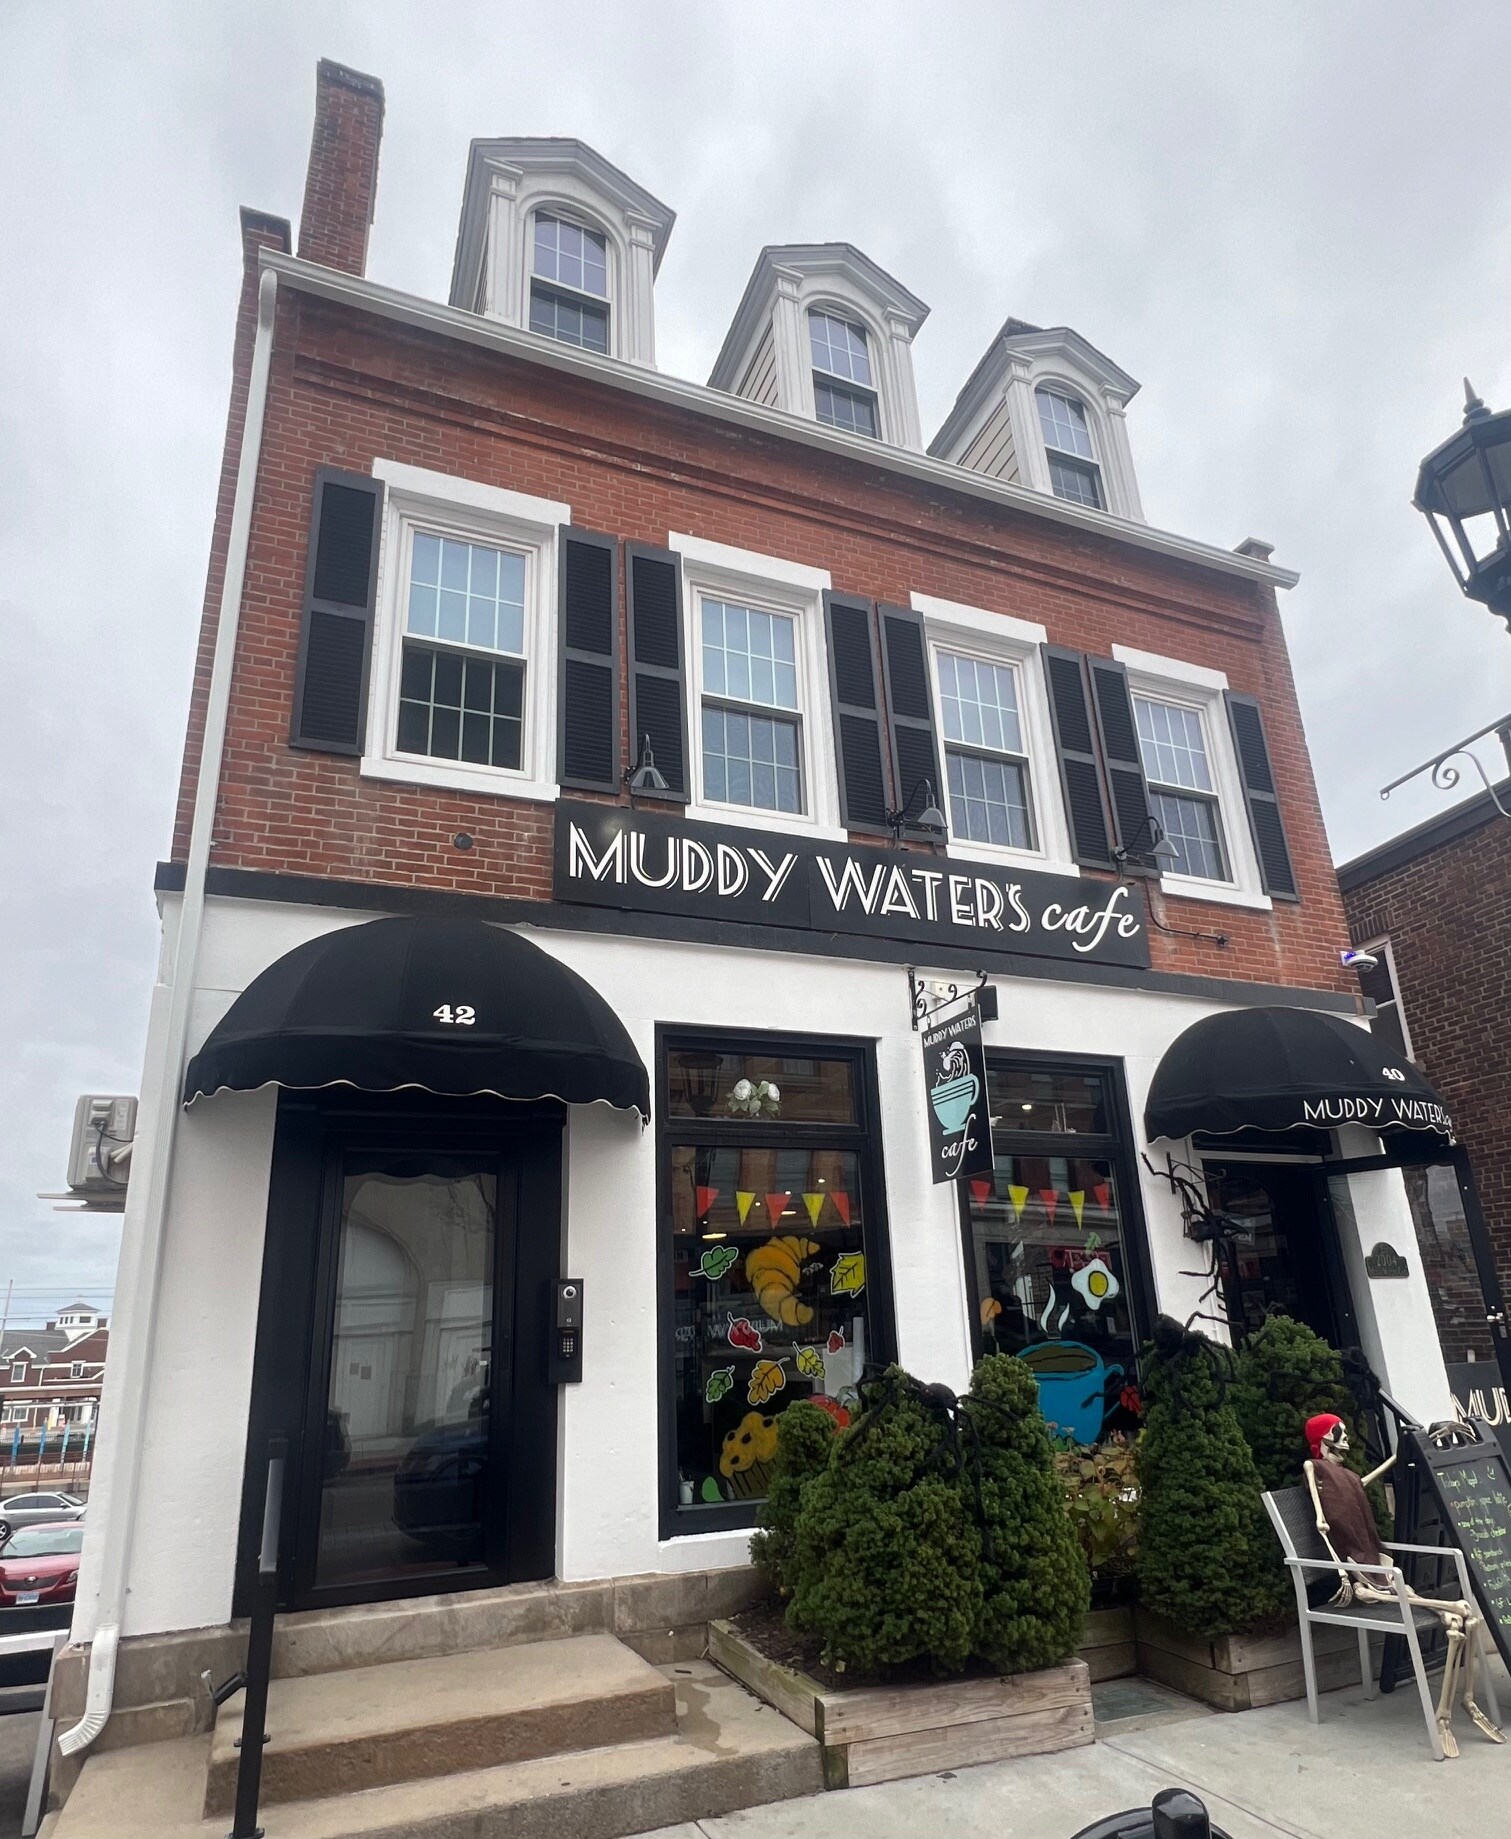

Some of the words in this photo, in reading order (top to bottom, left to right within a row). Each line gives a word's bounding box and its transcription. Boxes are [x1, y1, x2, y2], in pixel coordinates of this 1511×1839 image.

[569, 821, 798, 902] MUDDY
[1041, 887, 1140, 952] cafe
[433, 1004, 476, 1025] 42
[923, 1027, 948, 1048] MUDDY
[1382, 1067, 1405, 1081] 40
[1303, 1097, 1384, 1120] MUDDY
[941, 1113, 978, 1177] cafe
